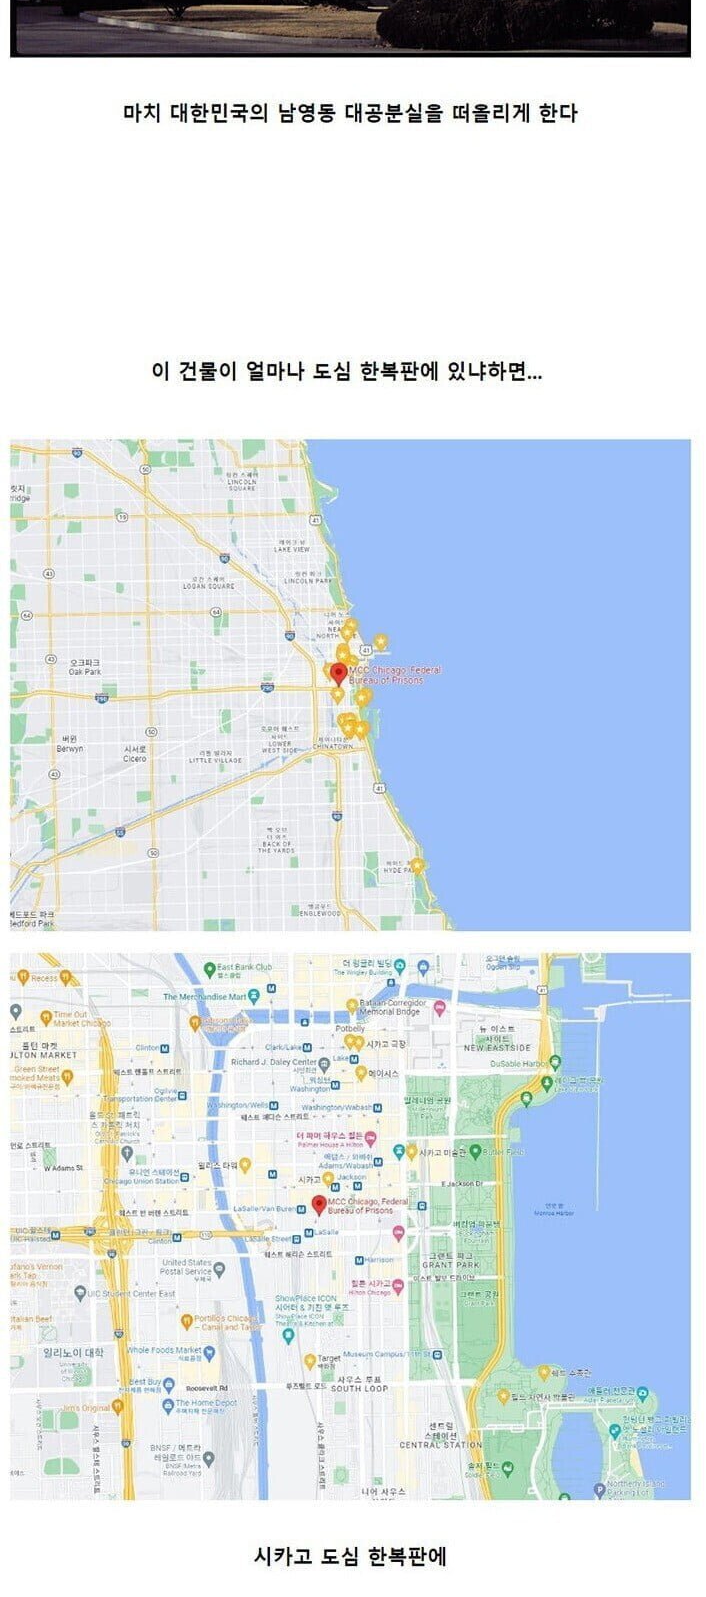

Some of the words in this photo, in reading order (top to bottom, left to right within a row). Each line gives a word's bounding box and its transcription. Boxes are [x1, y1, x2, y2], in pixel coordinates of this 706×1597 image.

[70, 658, 101, 667] 오크파크
[68, 668, 82, 676] Oak
[84, 668, 102, 676] Park
[348, 676, 379, 685] Bureau
[380, 676, 390, 685] of
[391, 676, 424, 685] Prisons
[56, 745, 84, 754] Berwyn
[122, 755, 147, 763] Cicero
[163, 993, 178, 1001] The
[179, 993, 226, 1001] Merchandise
[228, 993, 247, 1001] Mart
[359, 1008, 395, 1016] Memorial
[396, 1008, 421, 1017] Bridge
[335, 1025, 366, 1033] Potbelly
[463, 1044, 484, 1052] NEW
[487, 1044, 532, 1052] EASTSIDE
[231, 1058, 260, 1066] Richard
[261, 1058, 269, 1066] J.
[270, 1058, 292, 1068] Daley
[291, 1058, 317, 1066] Center
[327, 1197, 346, 1206] MCC
[347, 1197, 380, 1207] Chicago,
[381, 1197, 409, 1205] Federal
[327, 1207, 355, 1215] Bureau
[355, 1206, 364, 1215] of
[365, 1207, 394, 1215] Prisons
[422, 1261, 453, 1269] GRANT
[456, 1261, 480, 1269] PARK
[43, 1347, 82, 1359] 일리노이
[84, 1347, 105, 1358] 대학
[331, 1385, 362, 1393] SOUTH
[364, 1385, 389, 1393] LOOP
[399, 1441, 441, 1449] CENTRAL
[443, 1441, 483, 1449] STATION
